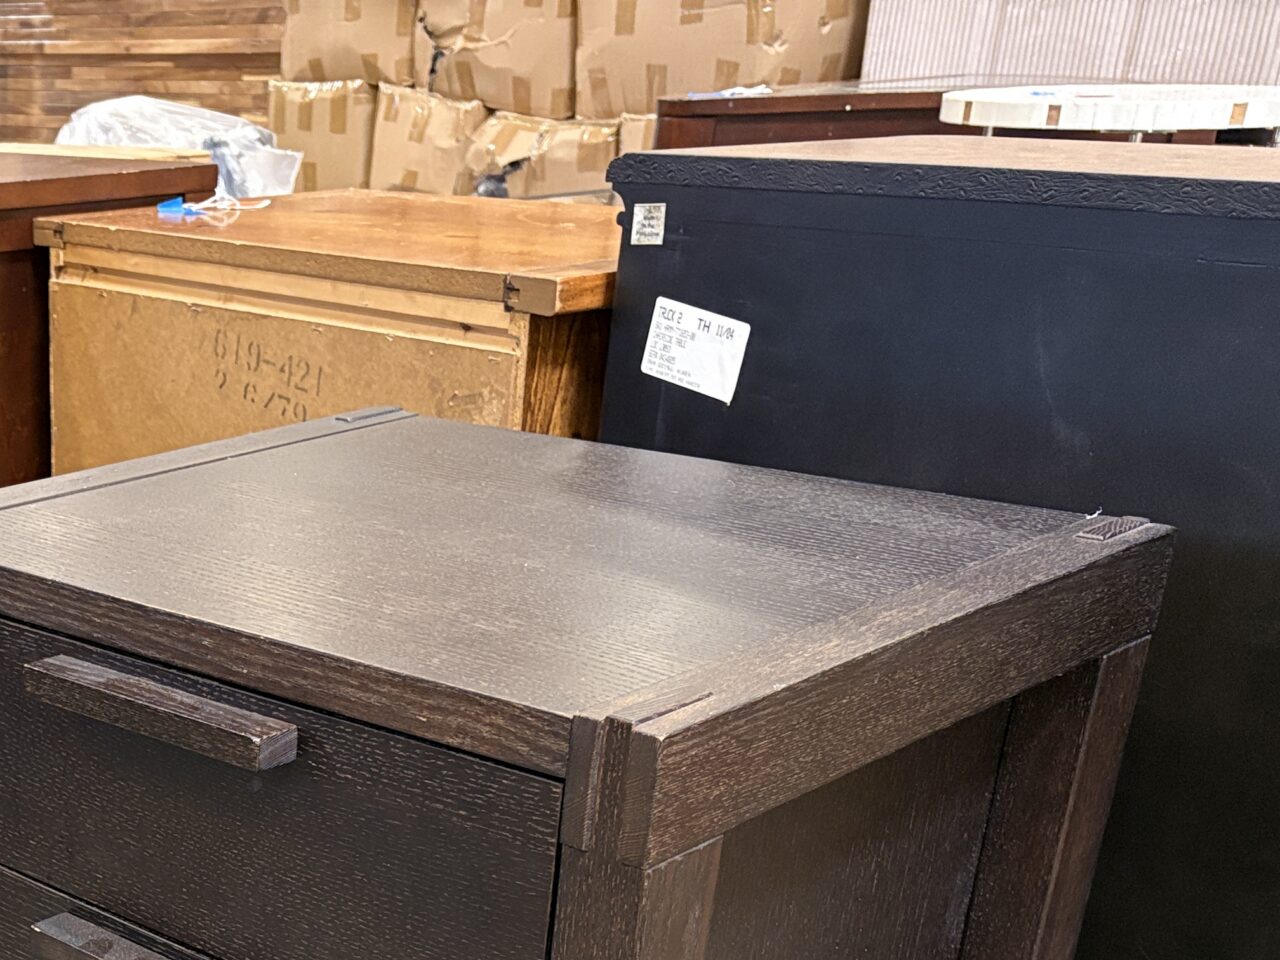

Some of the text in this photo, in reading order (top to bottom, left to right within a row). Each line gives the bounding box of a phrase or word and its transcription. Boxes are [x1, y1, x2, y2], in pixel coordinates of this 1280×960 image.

[677, 312, 683, 325] 2
[697, 318, 711, 334] TH
[214, 329, 322, 397] 619-421
